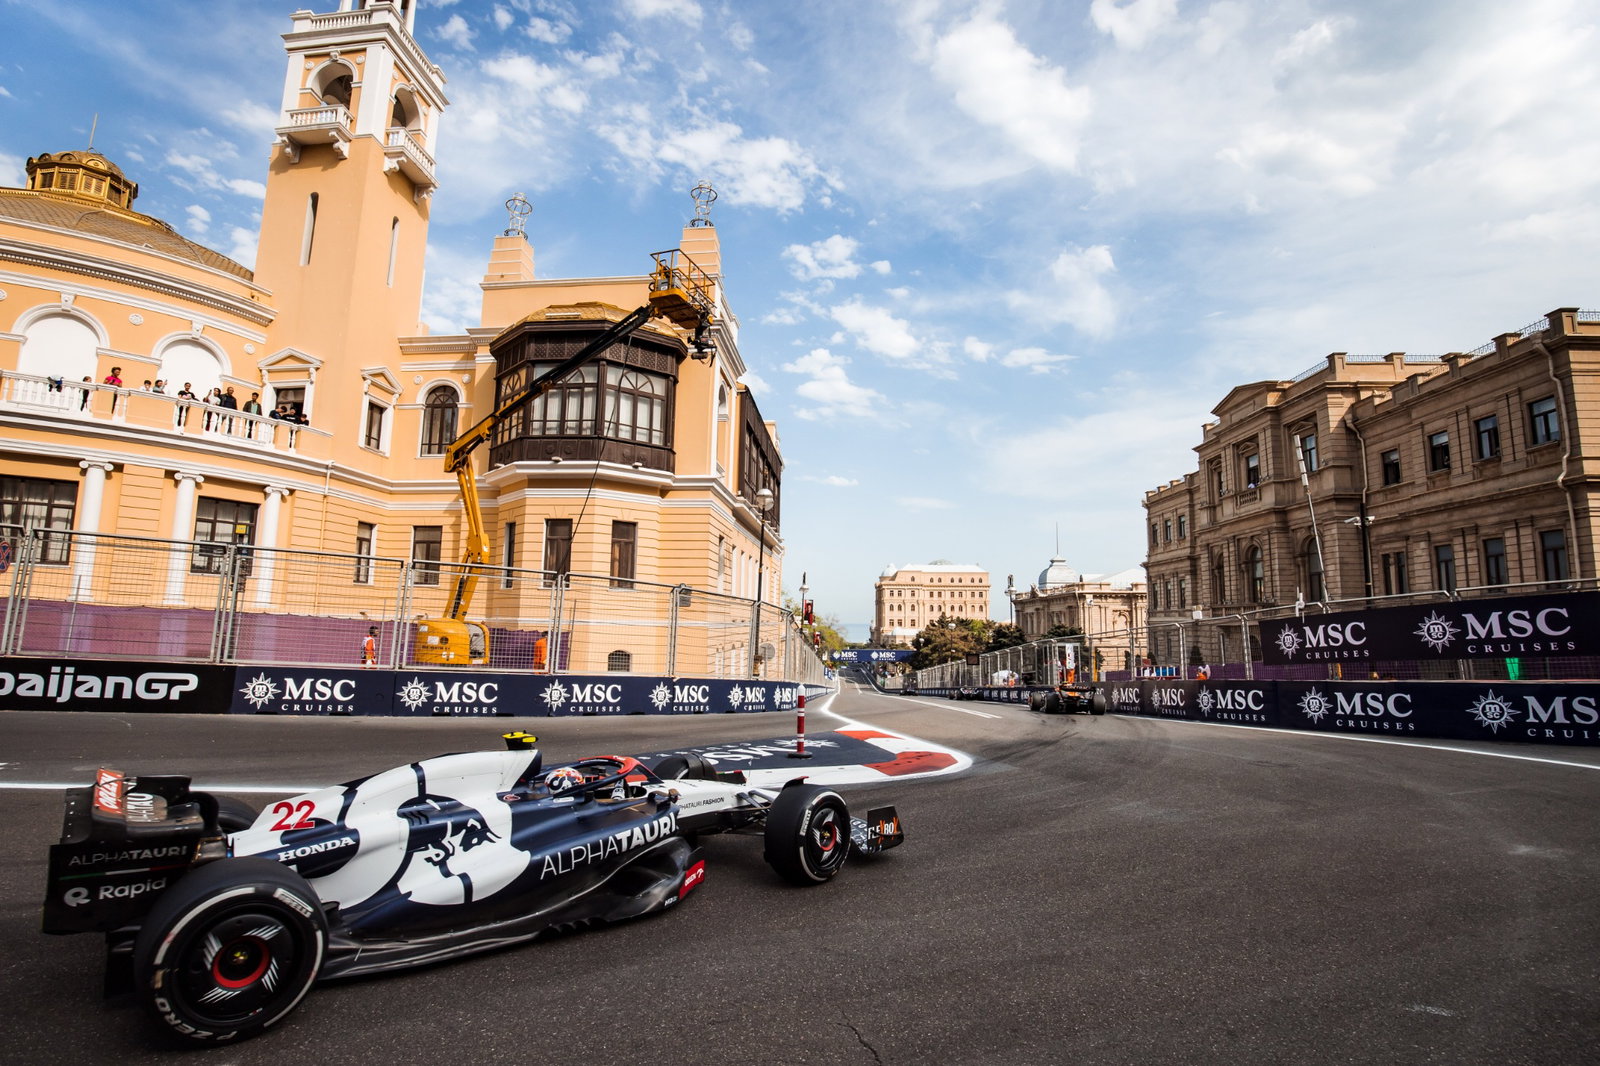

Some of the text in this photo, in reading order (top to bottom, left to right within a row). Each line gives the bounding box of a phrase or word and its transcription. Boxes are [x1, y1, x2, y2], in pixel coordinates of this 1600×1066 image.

[1462, 607, 1571, 640] MSC
[1303, 622, 1366, 648] MSC
[1306, 649, 1370, 660] CRUISES
[1467, 641, 1576, 654] CRUISES
[282, 678, 356, 702] MSC
[434, 682, 498, 704] MSC
[570, 684, 622, 703] MSC
[674, 685, 710, 703] MSC
[744, 686, 766, 703] MSC
[1120, 688, 1140, 704] MSC
[1162, 688, 1186, 706] MSC
[281, 704, 354, 712] CRUISES
[1216, 689, 1264, 711] MSC
[1334, 692, 1413, 718] MSC
[433, 706, 497, 714] CRUISES
[1216, 712, 1266, 722] CRUISES
[1336, 719, 1415, 730] CRUISES
[1527, 728, 1600, 739] CRUI
[269, 800, 316, 832] 22
[278, 836, 356, 862] HONDA
[540, 812, 678, 880] ALPHATAURI
[68, 846, 188, 866] ALPHATAURI
[98, 877, 167, 900] Rapid
